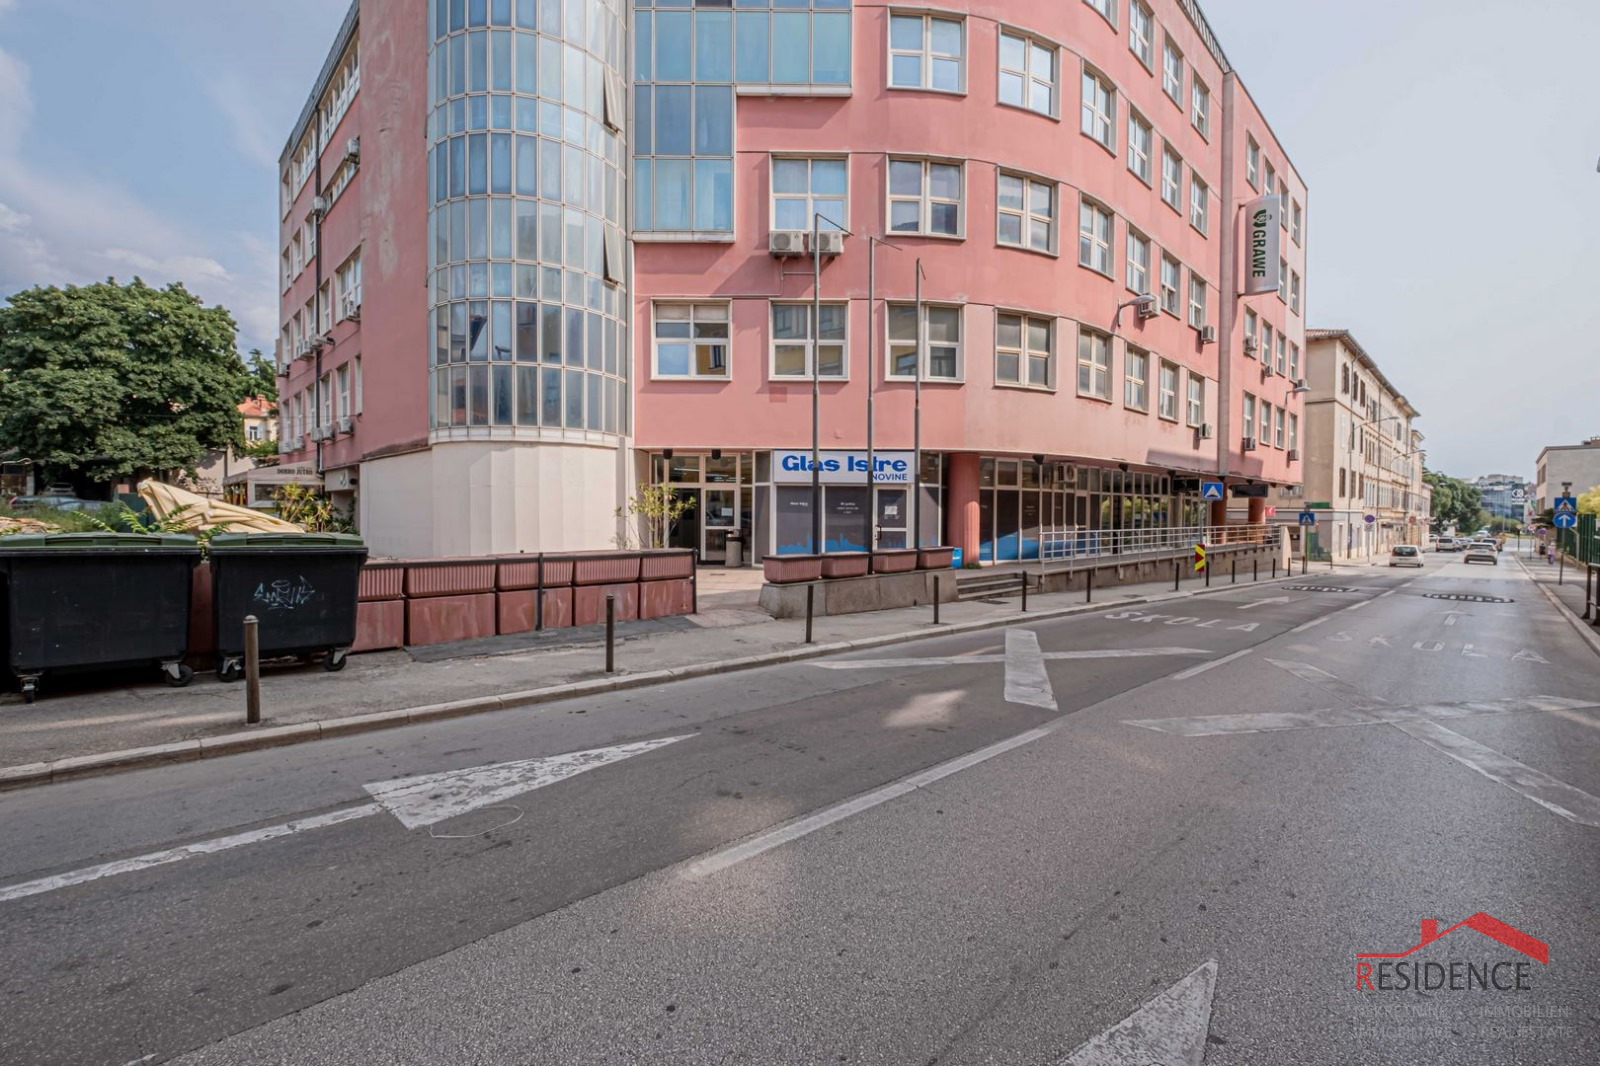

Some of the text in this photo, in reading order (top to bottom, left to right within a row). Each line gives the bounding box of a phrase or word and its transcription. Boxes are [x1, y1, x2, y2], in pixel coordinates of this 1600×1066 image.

[1252, 230, 1266, 277] GRAWE
[782, 455, 907, 472] Glas Istre
[872, 473, 908, 481] NOVINE
